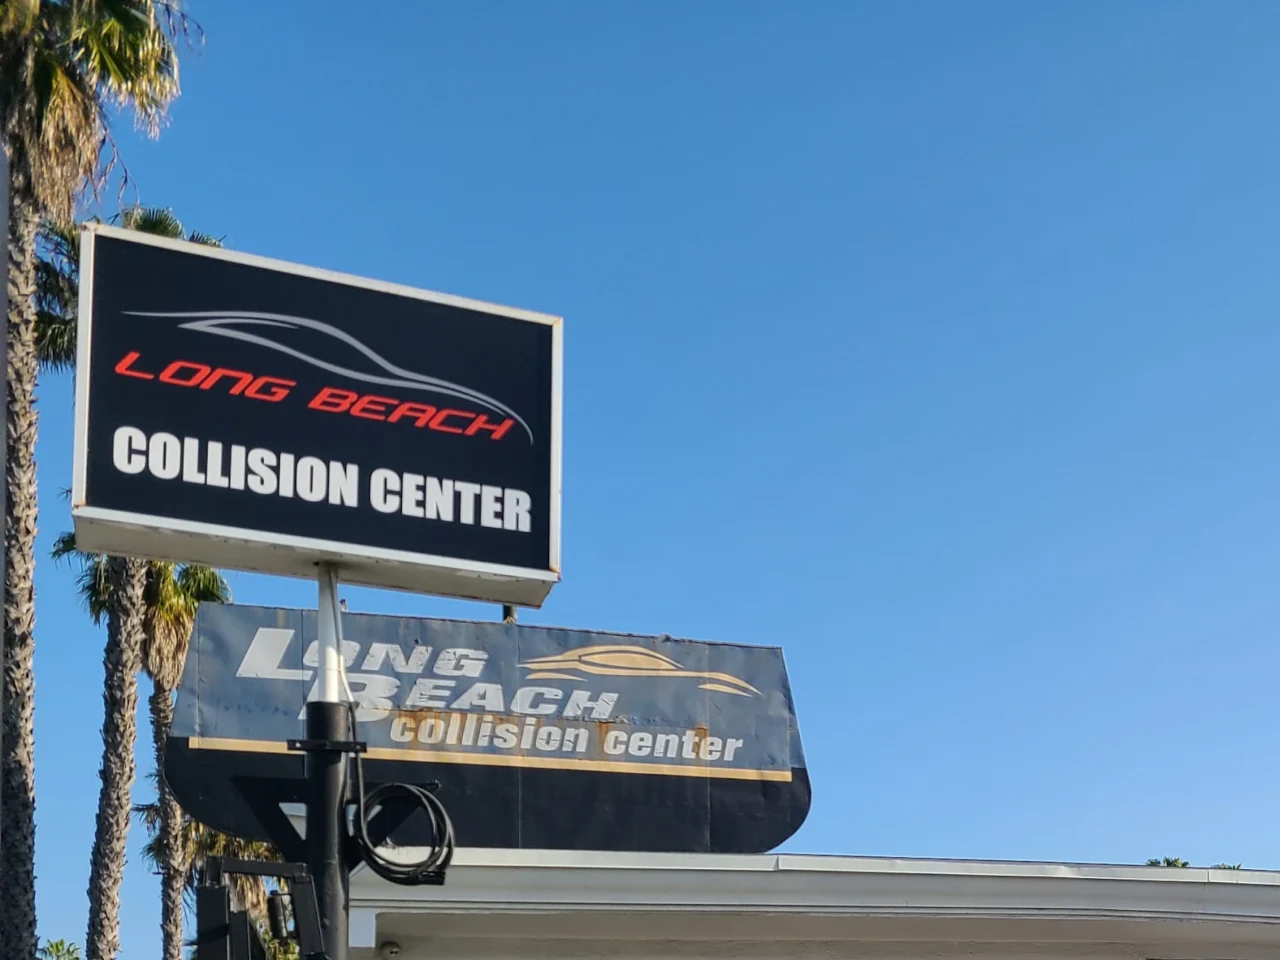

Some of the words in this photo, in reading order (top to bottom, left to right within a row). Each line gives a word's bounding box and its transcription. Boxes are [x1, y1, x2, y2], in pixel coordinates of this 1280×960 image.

[114, 350, 297, 403] LONG
[307, 386, 516, 441] BEACH
[112, 426, 359, 508] COLLISION
[369, 467, 532, 534] CENTER
[235, 627, 490, 681] LONG
[297, 671, 620, 723] BEACH
[389, 711, 589, 753] collision
[603, 728, 744, 762] center
